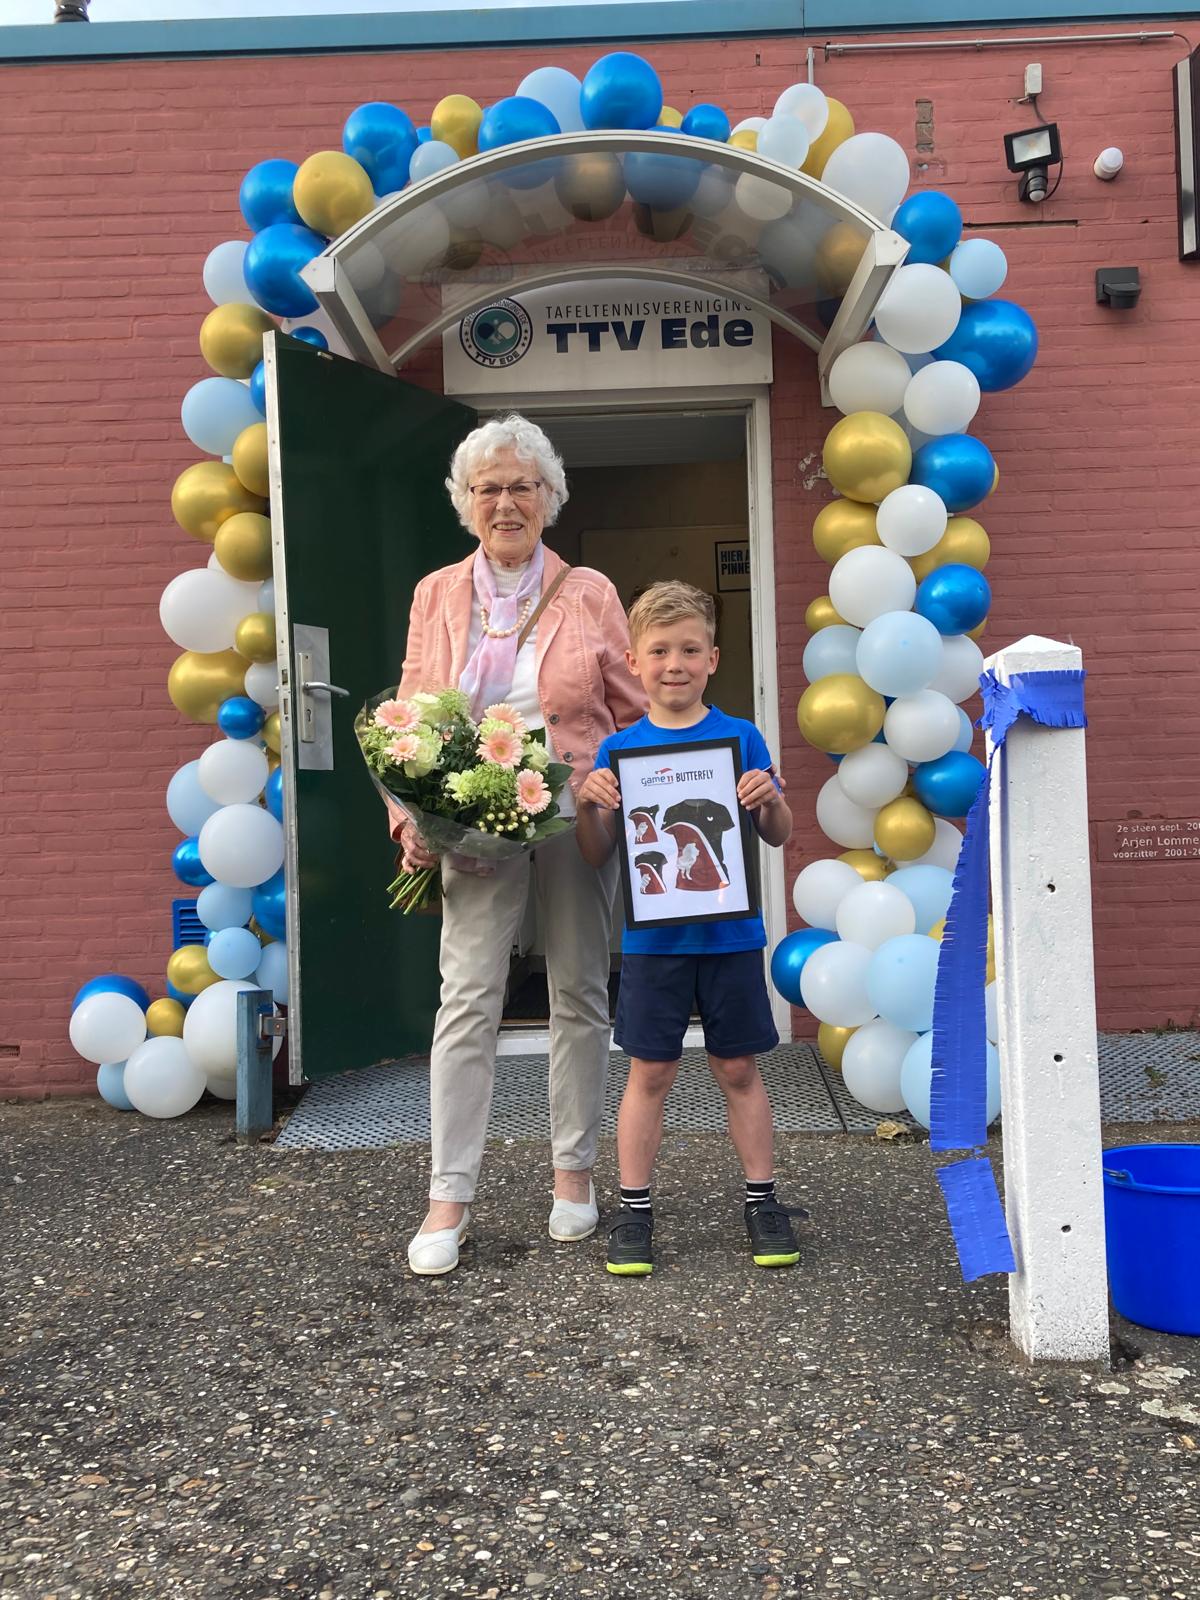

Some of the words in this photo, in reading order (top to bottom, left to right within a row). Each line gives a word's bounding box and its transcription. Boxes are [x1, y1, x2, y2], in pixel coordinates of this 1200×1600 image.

[546, 319, 646, 354] TTV
[661, 314, 754, 350] Ede
[475, 351, 497, 365] TTV
[499, 350, 520, 365] EDE
[720, 549, 743, 562] HIER
[675, 769, 714, 783] BUTTERFLY
[1117, 825, 1129, 833] 2e
[1131, 824, 1157, 832] steen
[1121, 837, 1153, 849] Arjen
[1113, 850, 1159, 859] voorzitter
